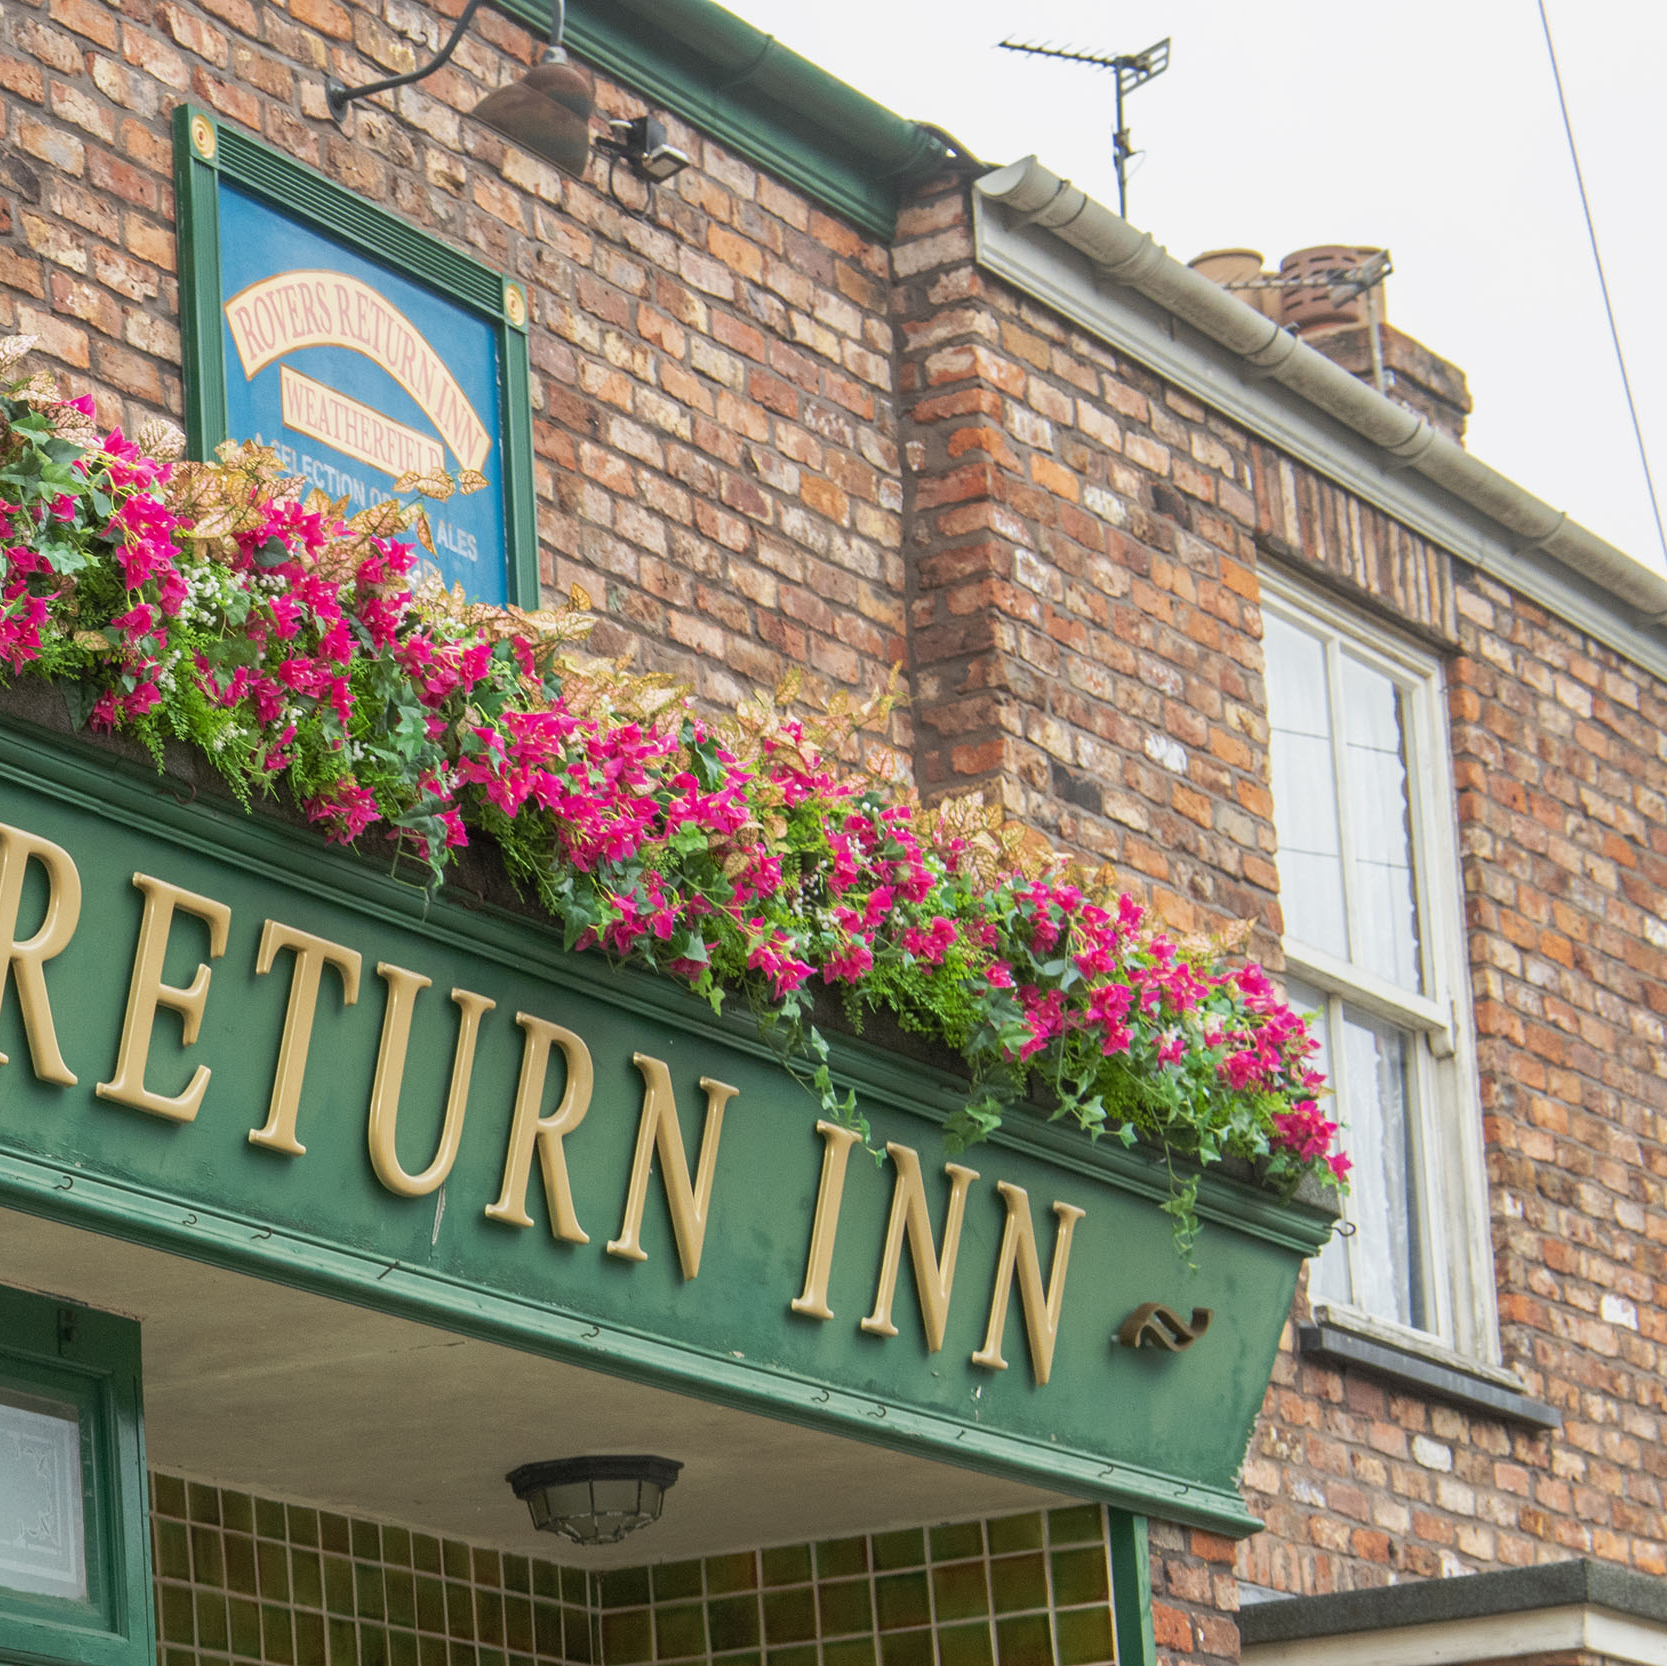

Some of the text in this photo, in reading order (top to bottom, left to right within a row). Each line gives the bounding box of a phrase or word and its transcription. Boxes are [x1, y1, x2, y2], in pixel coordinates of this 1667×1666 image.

[234, 281, 483, 467] ROVERS RETURN INN
[284, 376, 444, 477] WEATHERFIELD
[269, 439, 365, 508] SELECTION
[436, 519, 478, 562] ALES
[790, 1119, 1086, 1387] INN
